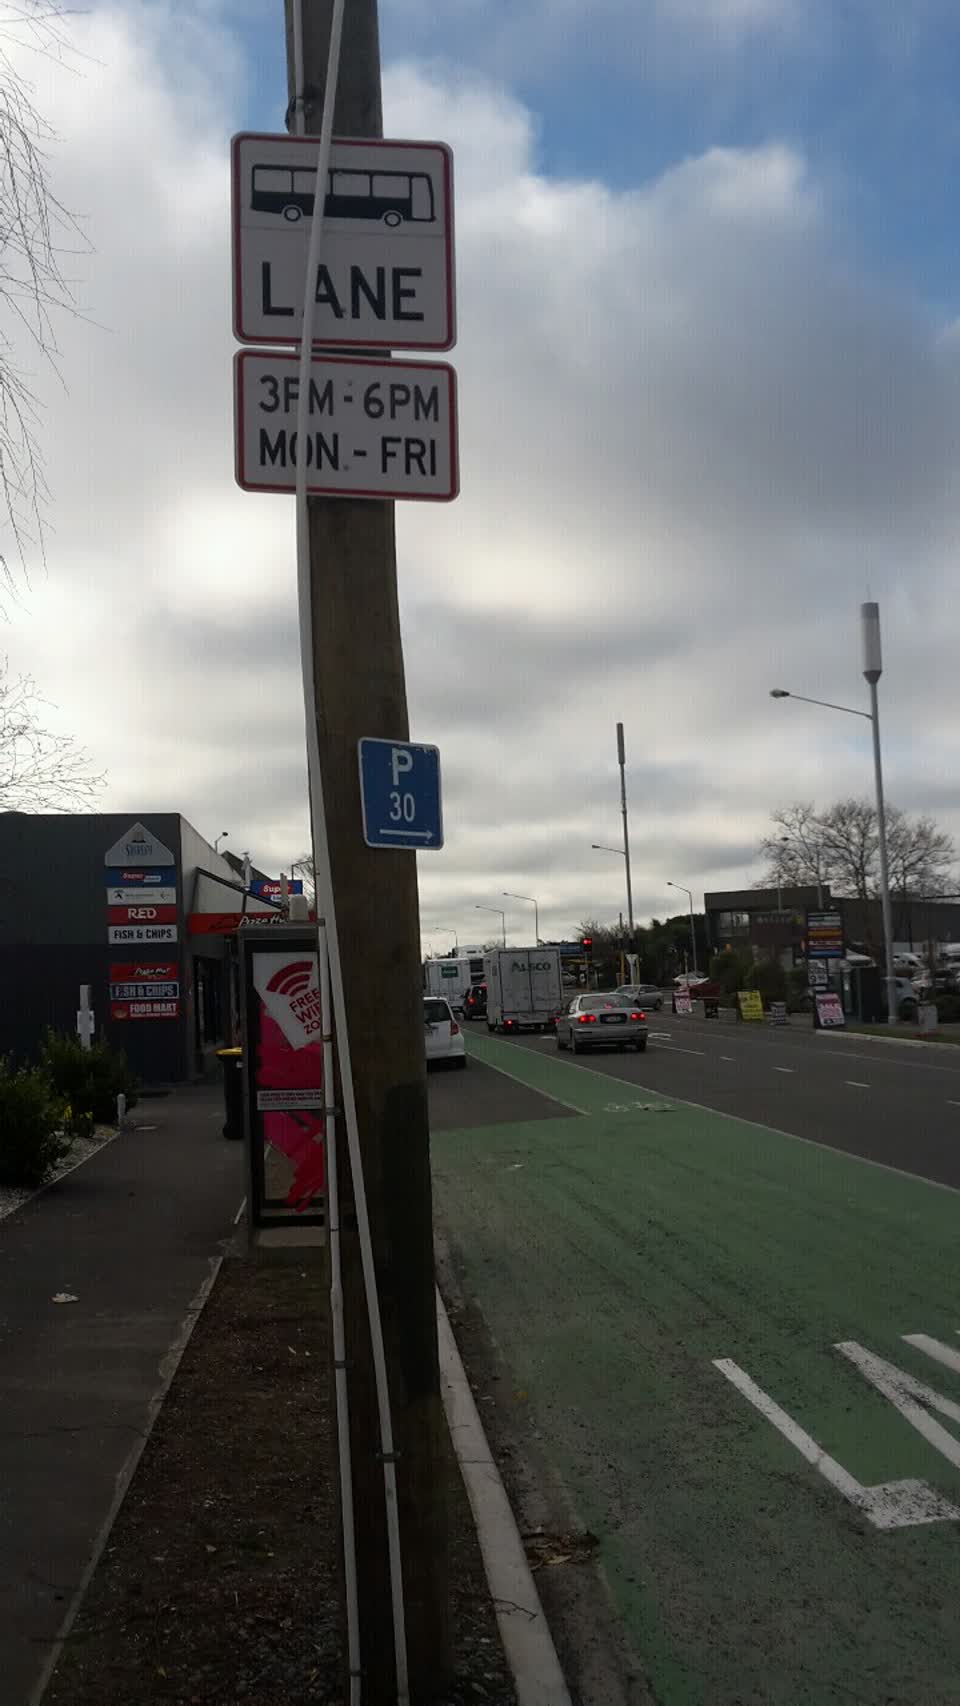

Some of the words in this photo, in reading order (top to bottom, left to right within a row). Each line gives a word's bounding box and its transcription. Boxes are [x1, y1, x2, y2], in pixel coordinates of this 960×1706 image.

[261, 261, 425, 322] LANE
[380, 435, 437, 477] FRI
[391, 747, 414, 786] P
[389, 791, 416, 822] 30
[263, 884, 291, 894] Supr
[128, 908, 157, 919] RED
[269, 914, 287, 923] Hu
[114, 929, 134, 939] FISH
[136, 929, 143, 938] &
[146, 928, 172, 939] CHIPS
